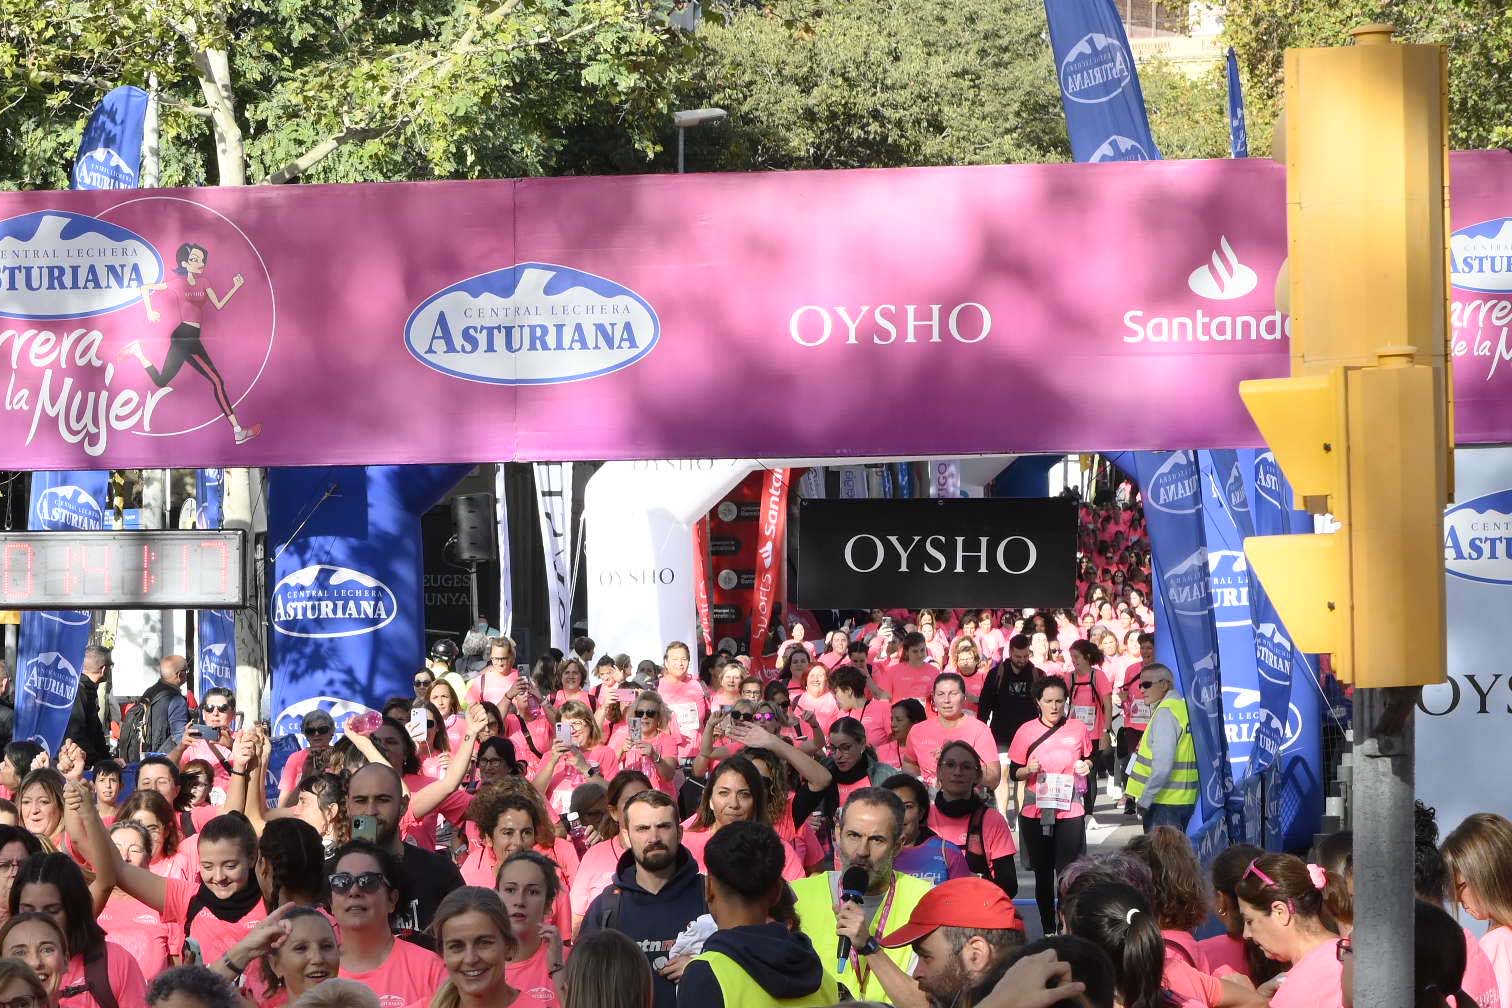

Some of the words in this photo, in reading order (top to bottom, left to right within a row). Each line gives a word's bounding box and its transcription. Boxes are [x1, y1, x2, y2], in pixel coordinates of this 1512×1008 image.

[67, 246, 139, 258] LECHERA
[464, 306, 542, 318] CENTRAL
[551, 303, 632, 315] LECHERA
[790, 302, 992, 348] OYSHO
[425, 309, 640, 355] ASTURIANA
[1472, 328, 1492, 357] la
[5, 369, 30, 411] la
[24, 362, 175, 456] Mujer
[844, 533, 1037, 575] OYSHO
[274, 594, 388, 622] ASTURIANA
[287, 589, 328, 599] CENTRAL
[334, 588, 383, 598] LECHERA
